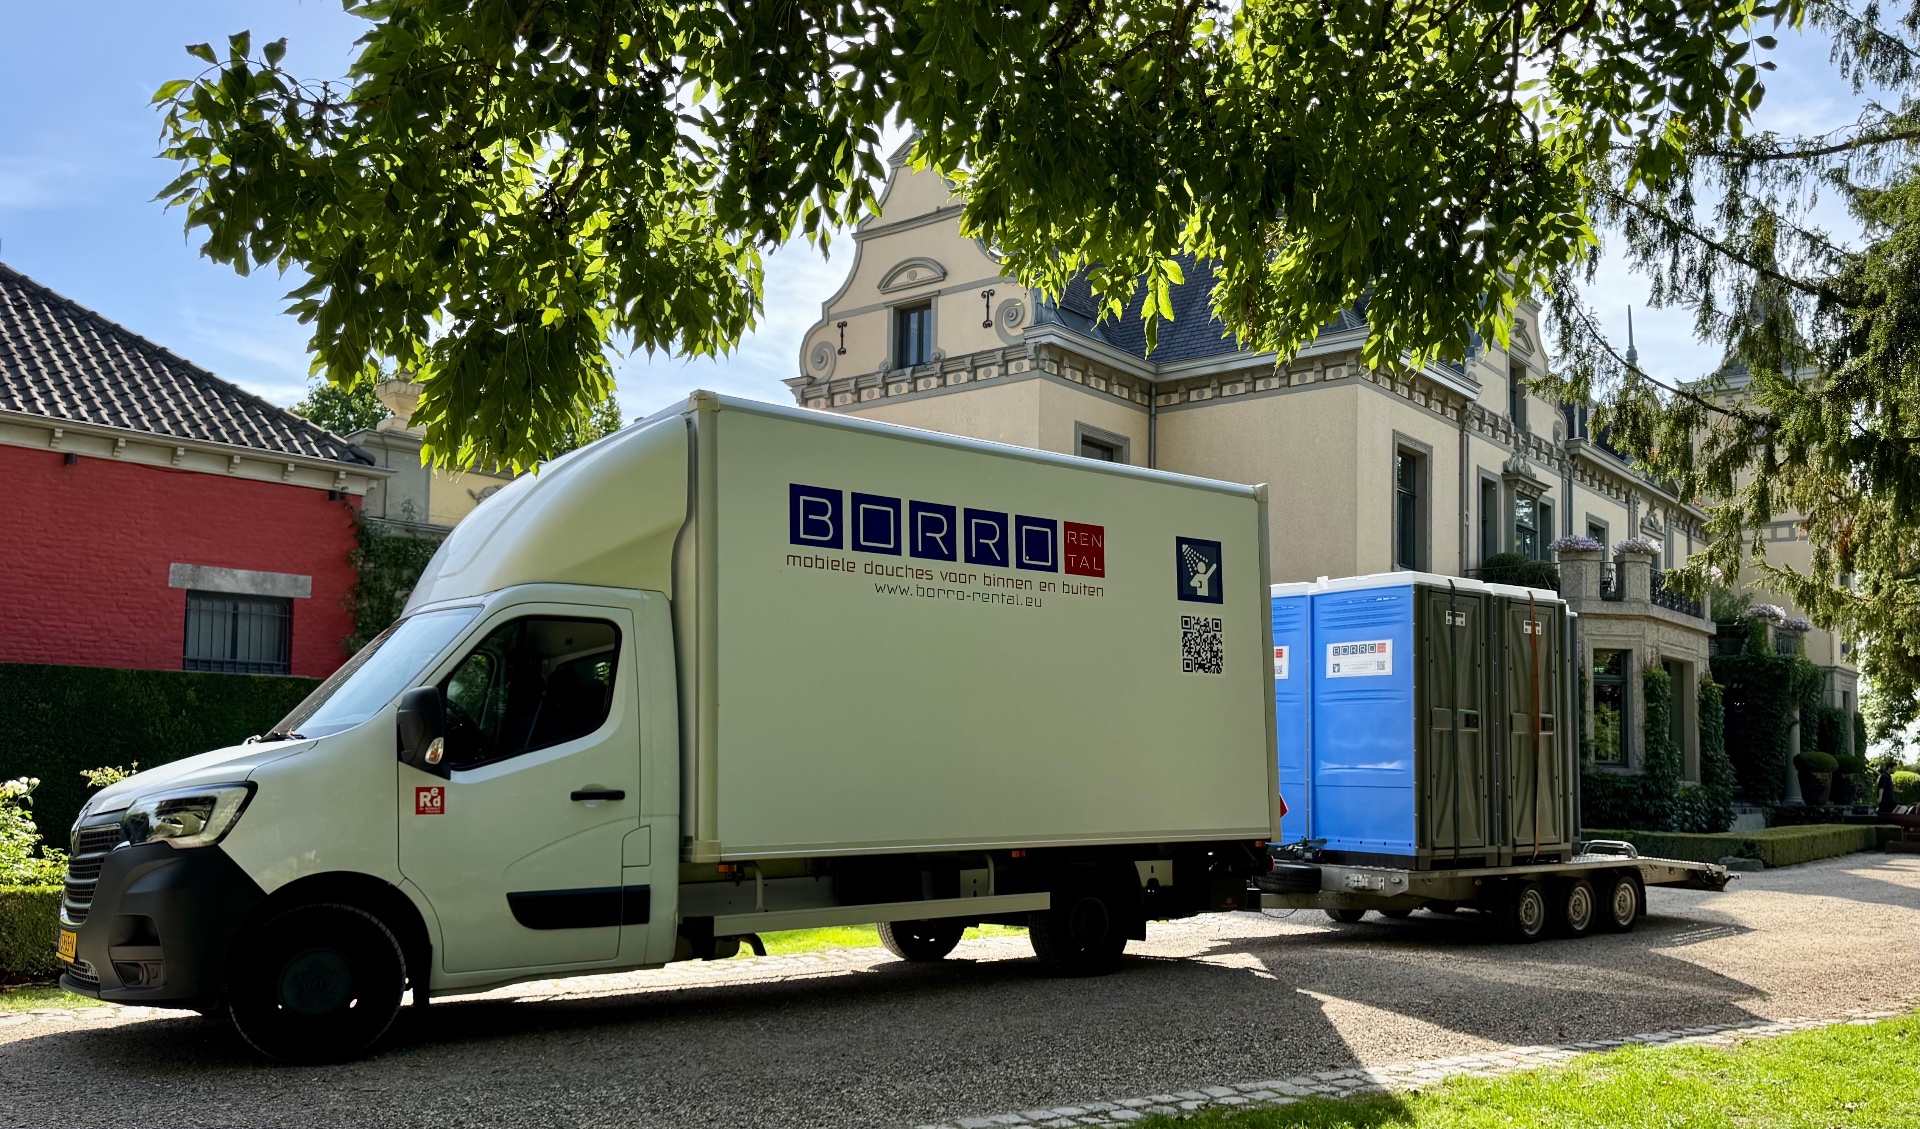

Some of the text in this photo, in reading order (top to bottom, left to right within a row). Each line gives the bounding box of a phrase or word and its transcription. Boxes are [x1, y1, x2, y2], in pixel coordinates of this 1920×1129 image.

[799, 495, 1052, 566] BORRO
[1067, 530, 1102, 547] REN
[1067, 554, 1102, 571] TAL
[786, 554, 1104, 598] mobiele douches voor binnen en buiten
[874, 582, 1042, 608] www.borro-rental.eu
[1333, 644, 1376, 655] BORRO
[419, 787, 441, 807] Red
